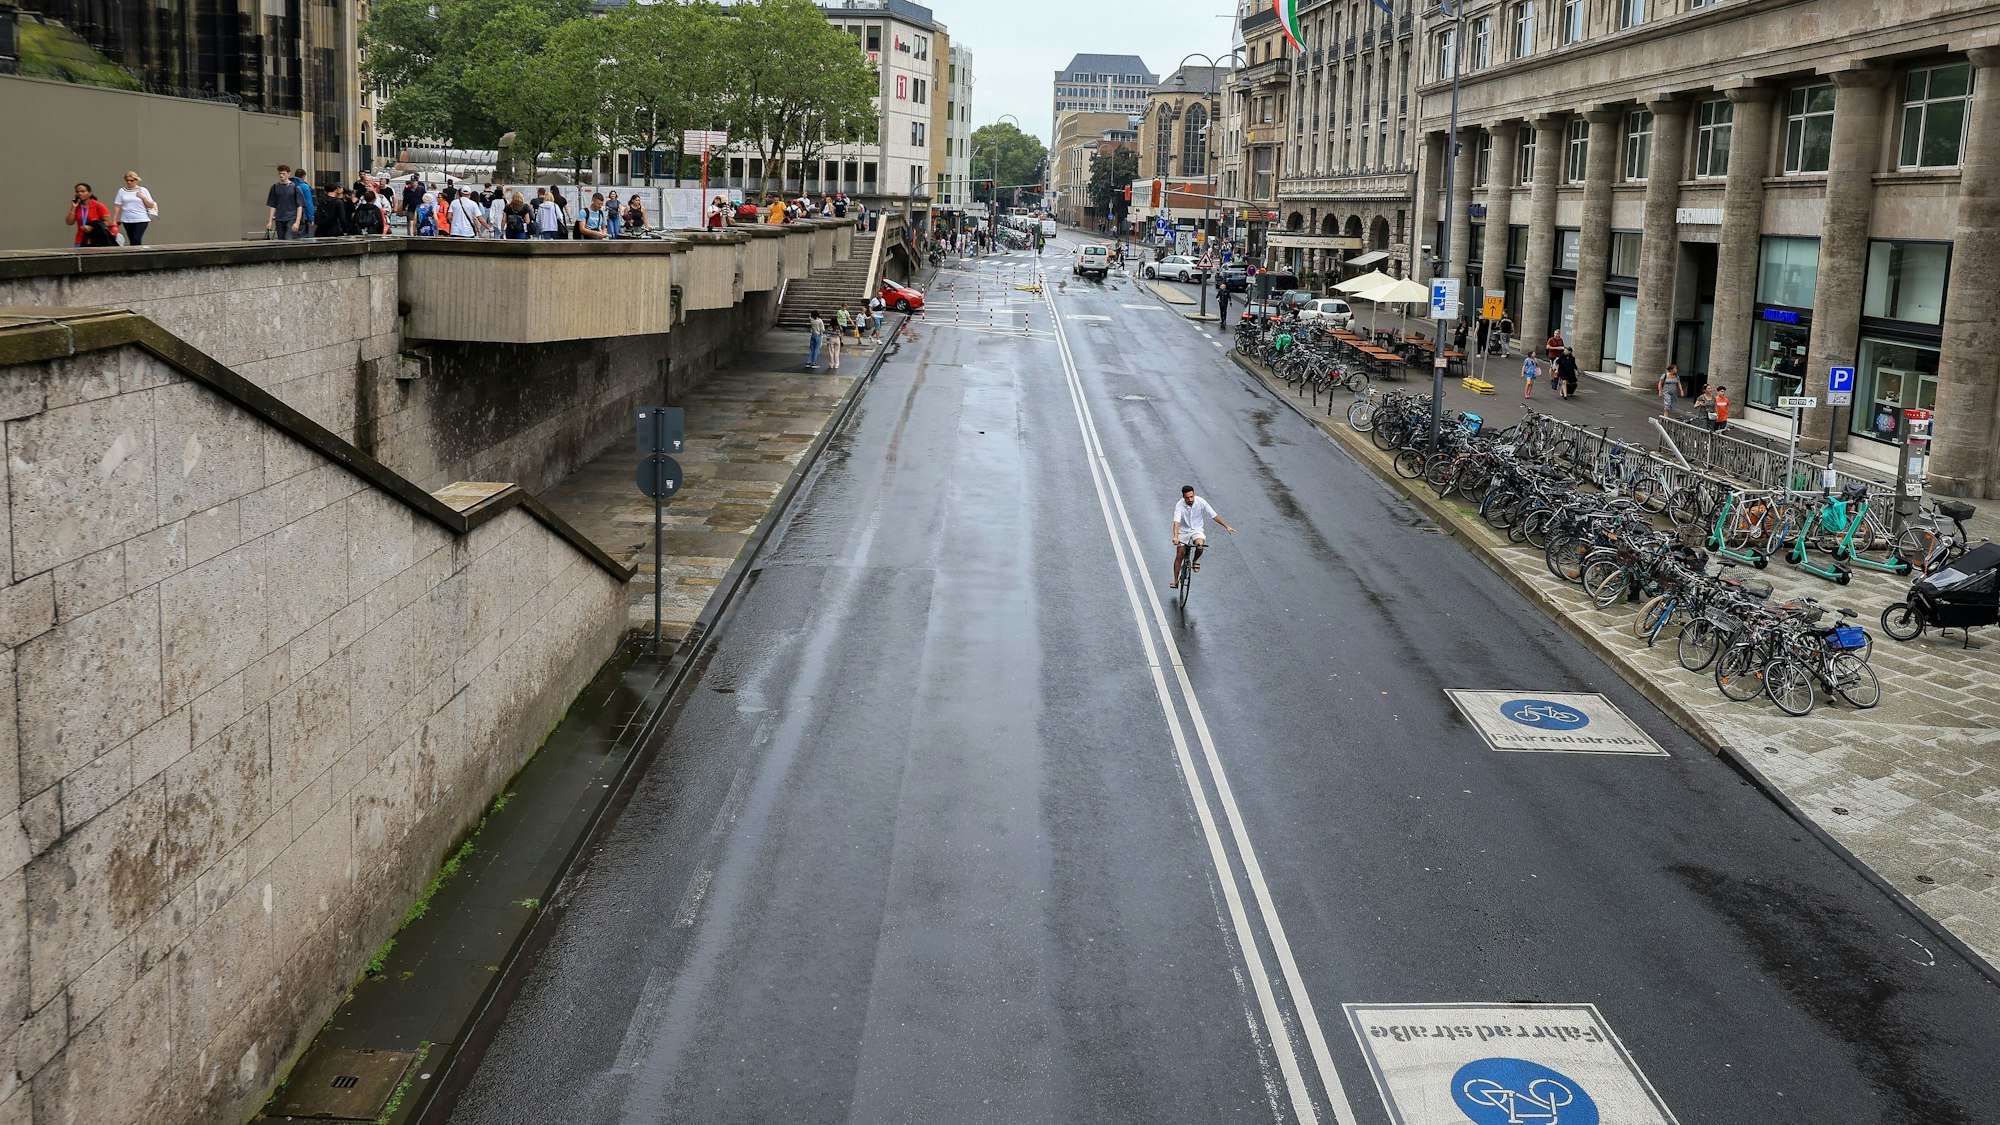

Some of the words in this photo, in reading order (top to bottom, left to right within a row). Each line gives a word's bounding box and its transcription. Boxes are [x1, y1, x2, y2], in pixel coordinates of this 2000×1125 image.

[1834, 370, 1848, 389] P
[1490, 733, 1646, 746] Fahrradstraße
[1370, 1024, 1604, 1042] Fahrradstraße
